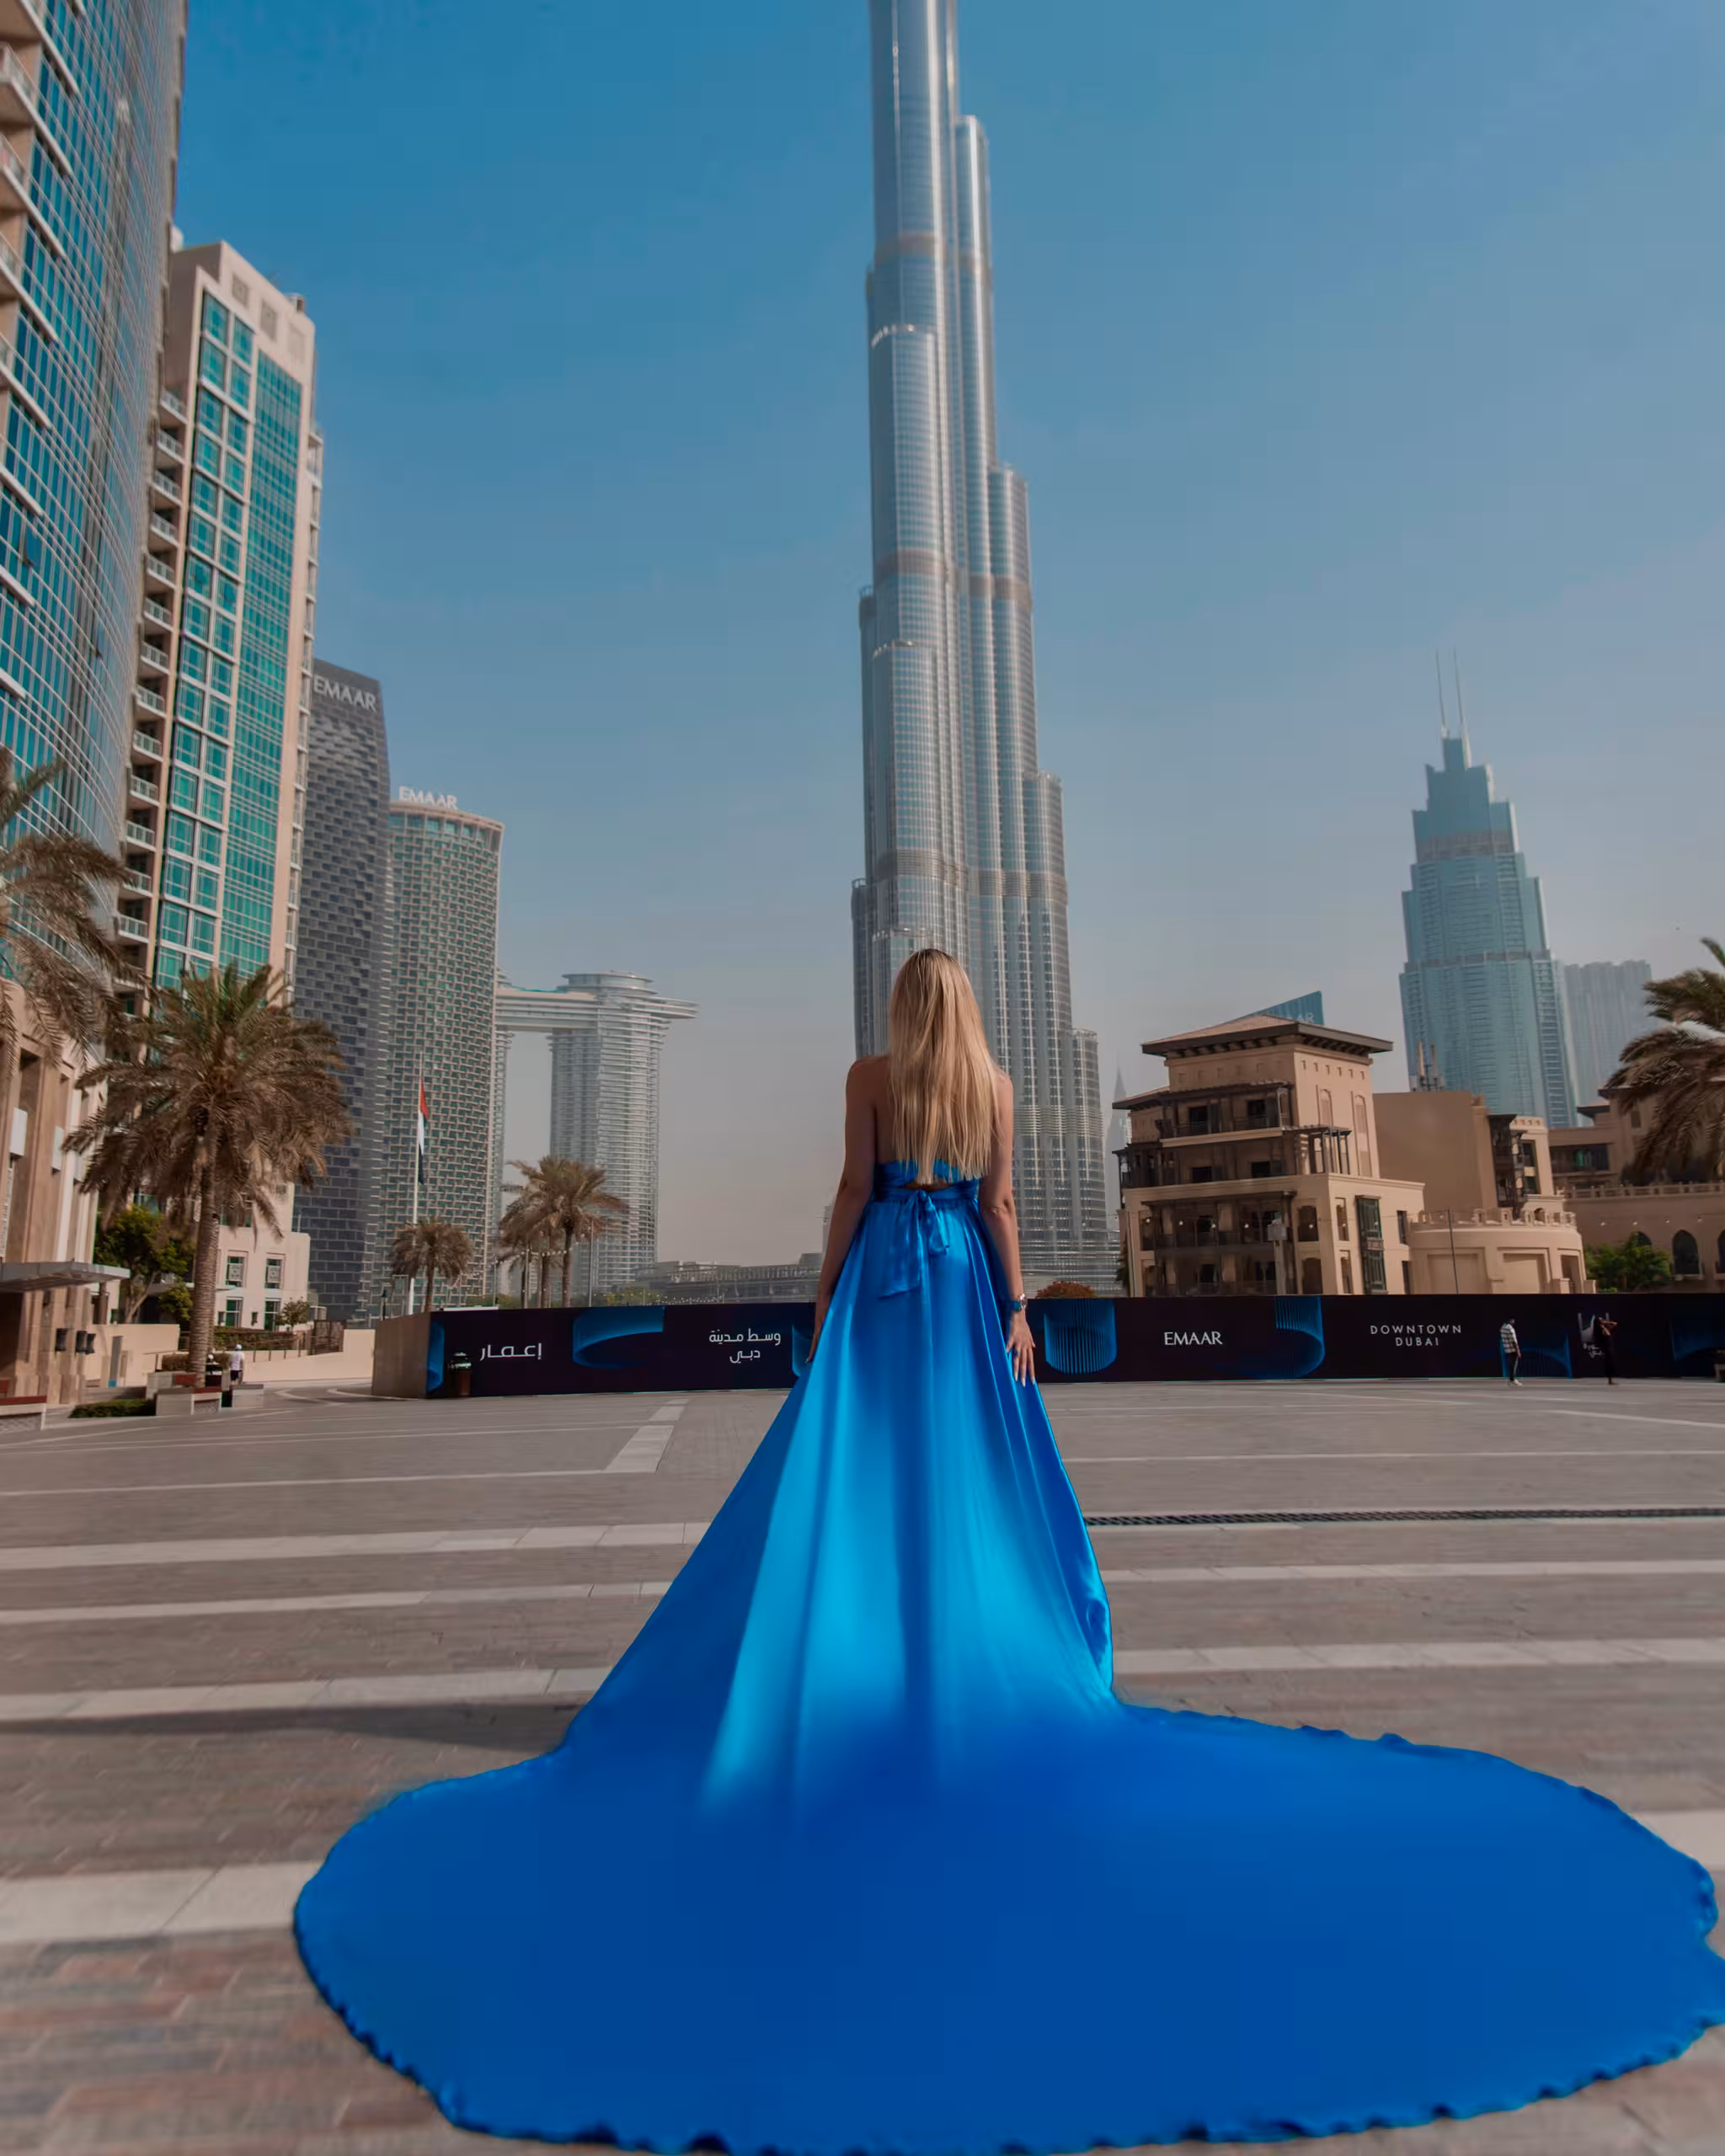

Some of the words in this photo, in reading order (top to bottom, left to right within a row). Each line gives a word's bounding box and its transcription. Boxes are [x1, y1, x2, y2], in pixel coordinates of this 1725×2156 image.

[313, 674, 377, 712] EMAAR
[398, 786, 458, 809] EMAAR
[709, 1328, 743, 1343] مدينة
[747, 1328, 781, 1345] وسط
[1370, 1324, 1462, 1334] DOWNTOWN
[1164, 1331, 1223, 1345] EMAAR
[1395, 1337, 1439, 1347] DUBAI
[479, 1342, 542, 1361] إعمار
[729, 1348, 761, 1364] دبي
